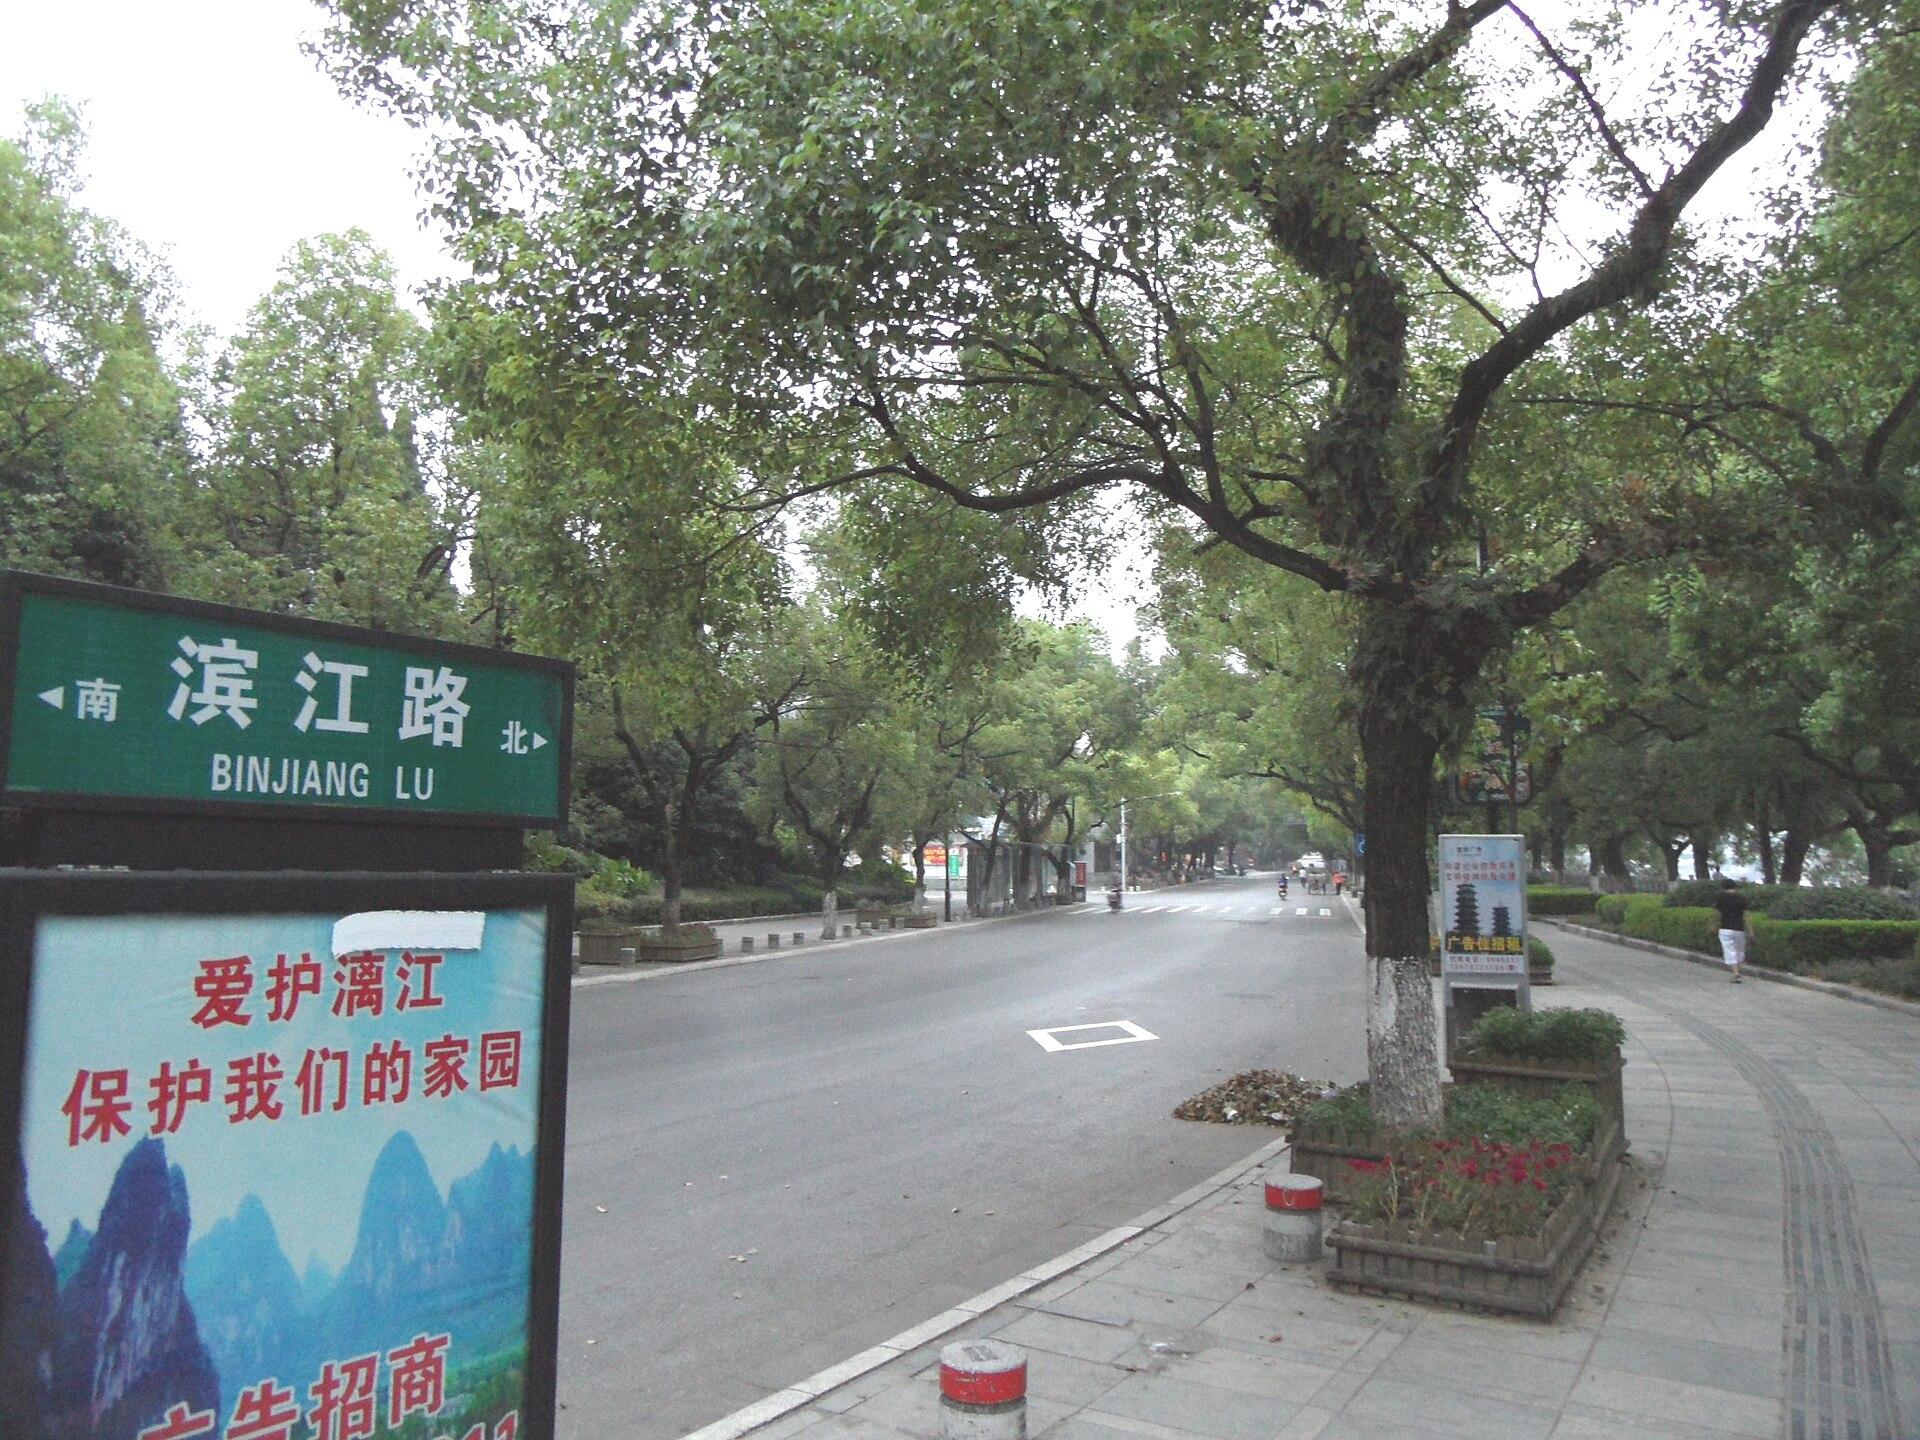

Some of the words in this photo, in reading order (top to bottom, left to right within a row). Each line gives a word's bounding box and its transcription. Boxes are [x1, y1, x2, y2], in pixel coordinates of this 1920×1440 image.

[75, 677, 121, 722] 南
[168, 636, 470, 748] 滨江路
[500, 720, 529, 754] 北
[211, 753, 370, 798] BINJIANG
[395, 765, 434, 800] LU
[191, 952, 444, 1029] 爱护漓江
[62, 1030, 522, 1146] 保护我们的家园
